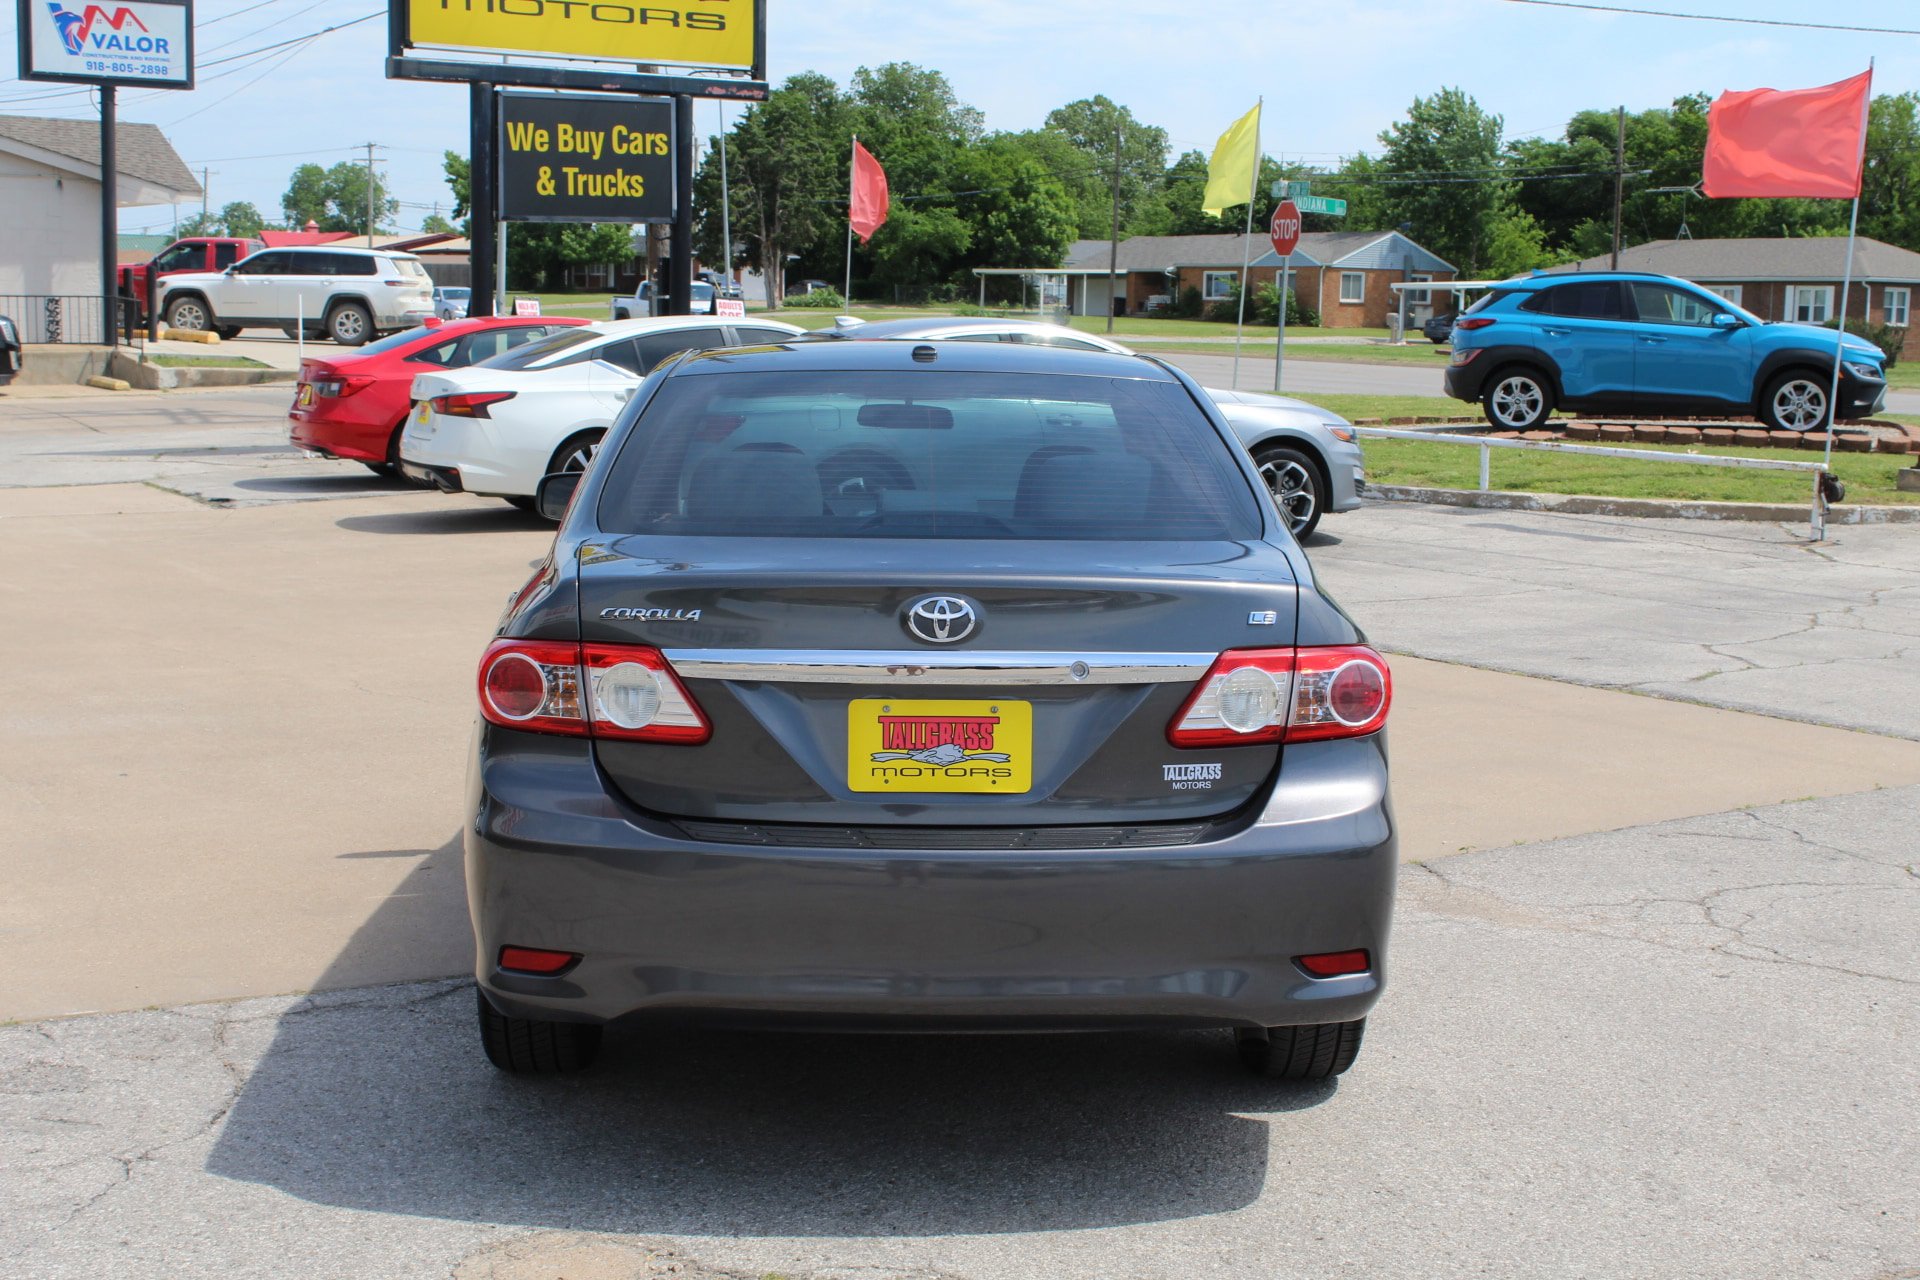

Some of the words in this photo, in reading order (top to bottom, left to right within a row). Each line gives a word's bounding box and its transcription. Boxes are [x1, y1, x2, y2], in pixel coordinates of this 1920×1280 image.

[90, 32, 170, 54] VALOR
[82, 52, 129, 60] CONSTRUCTION
[86, 61, 168, 75] 918-805-2898
[507, 121, 550, 152] We
[557, 123, 605, 160] Buy
[612, 124, 669, 156] Cars
[536, 165, 556, 197] &
[562, 166, 645, 198] Trucks
[1273, 219, 1297, 240] STOP
[599, 607, 702, 622] COROLLA
[1249, 611, 1277, 625] LE
[878, 716, 1001, 751] TALLGRASS
[871, 767, 1012, 778] MOTORS
[1162, 763, 1222, 781] TALLGRASS
[1172, 781, 1212, 791] MOTORS
